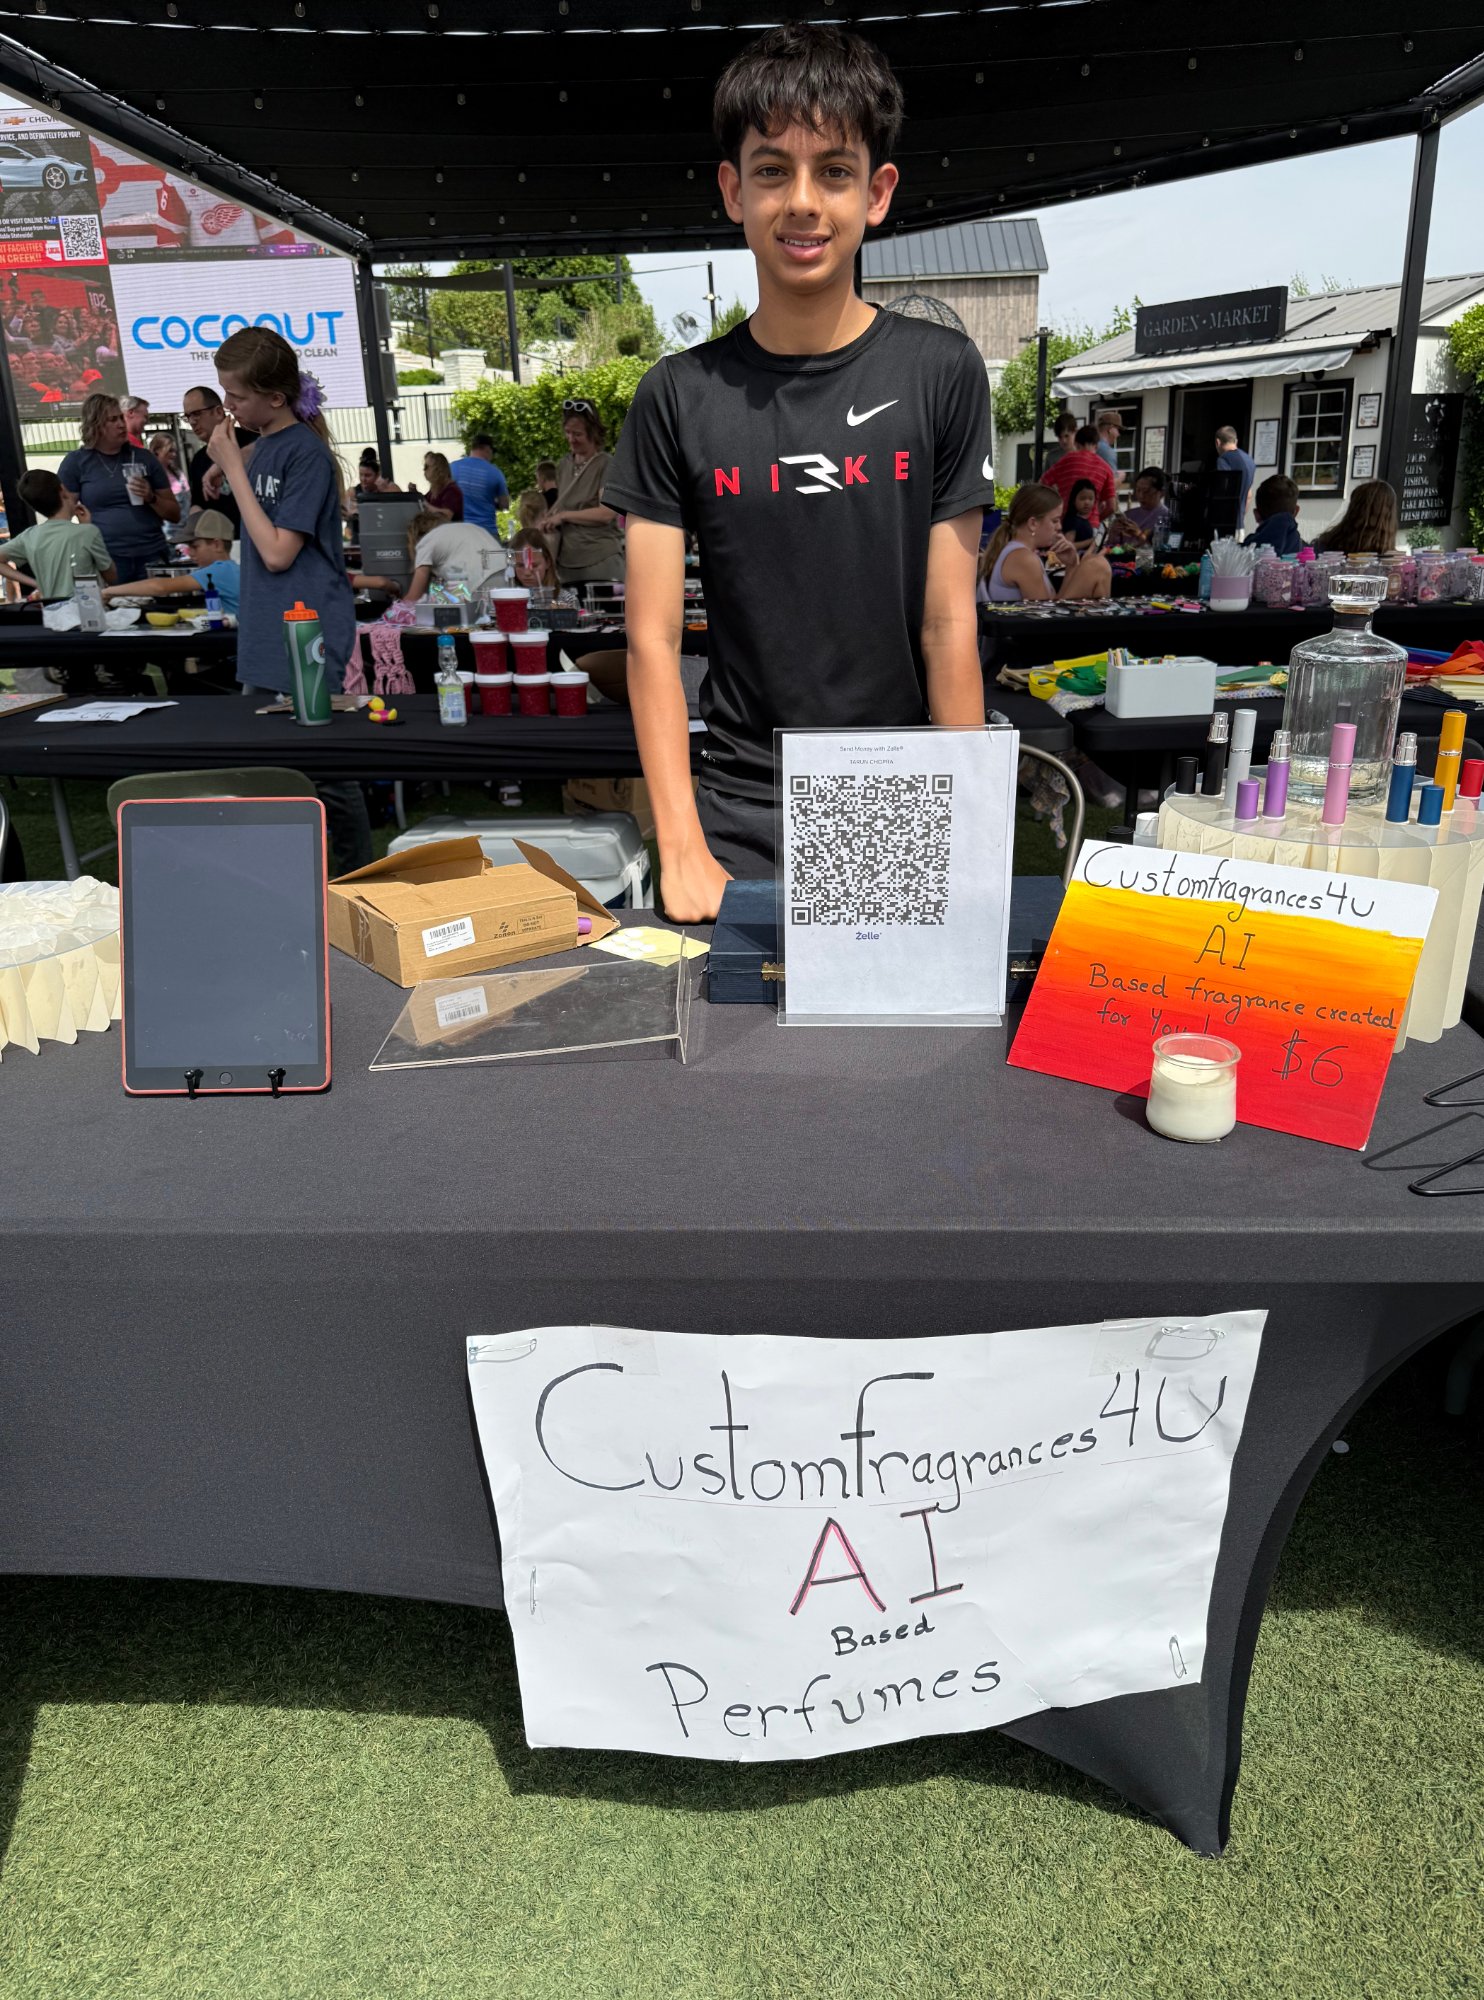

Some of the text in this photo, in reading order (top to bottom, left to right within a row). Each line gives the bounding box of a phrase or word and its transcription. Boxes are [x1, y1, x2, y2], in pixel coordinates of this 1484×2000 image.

[1143, 305, 1272, 338] GARDEN MARKET
[190, 351, 212, 360] THE
[305, 348, 338, 358] CLEAN
[1194, 924, 1256, 971] AI
[1089, 962, 1397, 1030] Based fragrance created
[1097, 998, 1129, 1027] for
[1272, 1029, 1349, 1087] $6
[789, 1505, 965, 1616] AI
[831, 1614, 936, 1656] Based
[646, 1660, 1002, 1739] Perfumes
